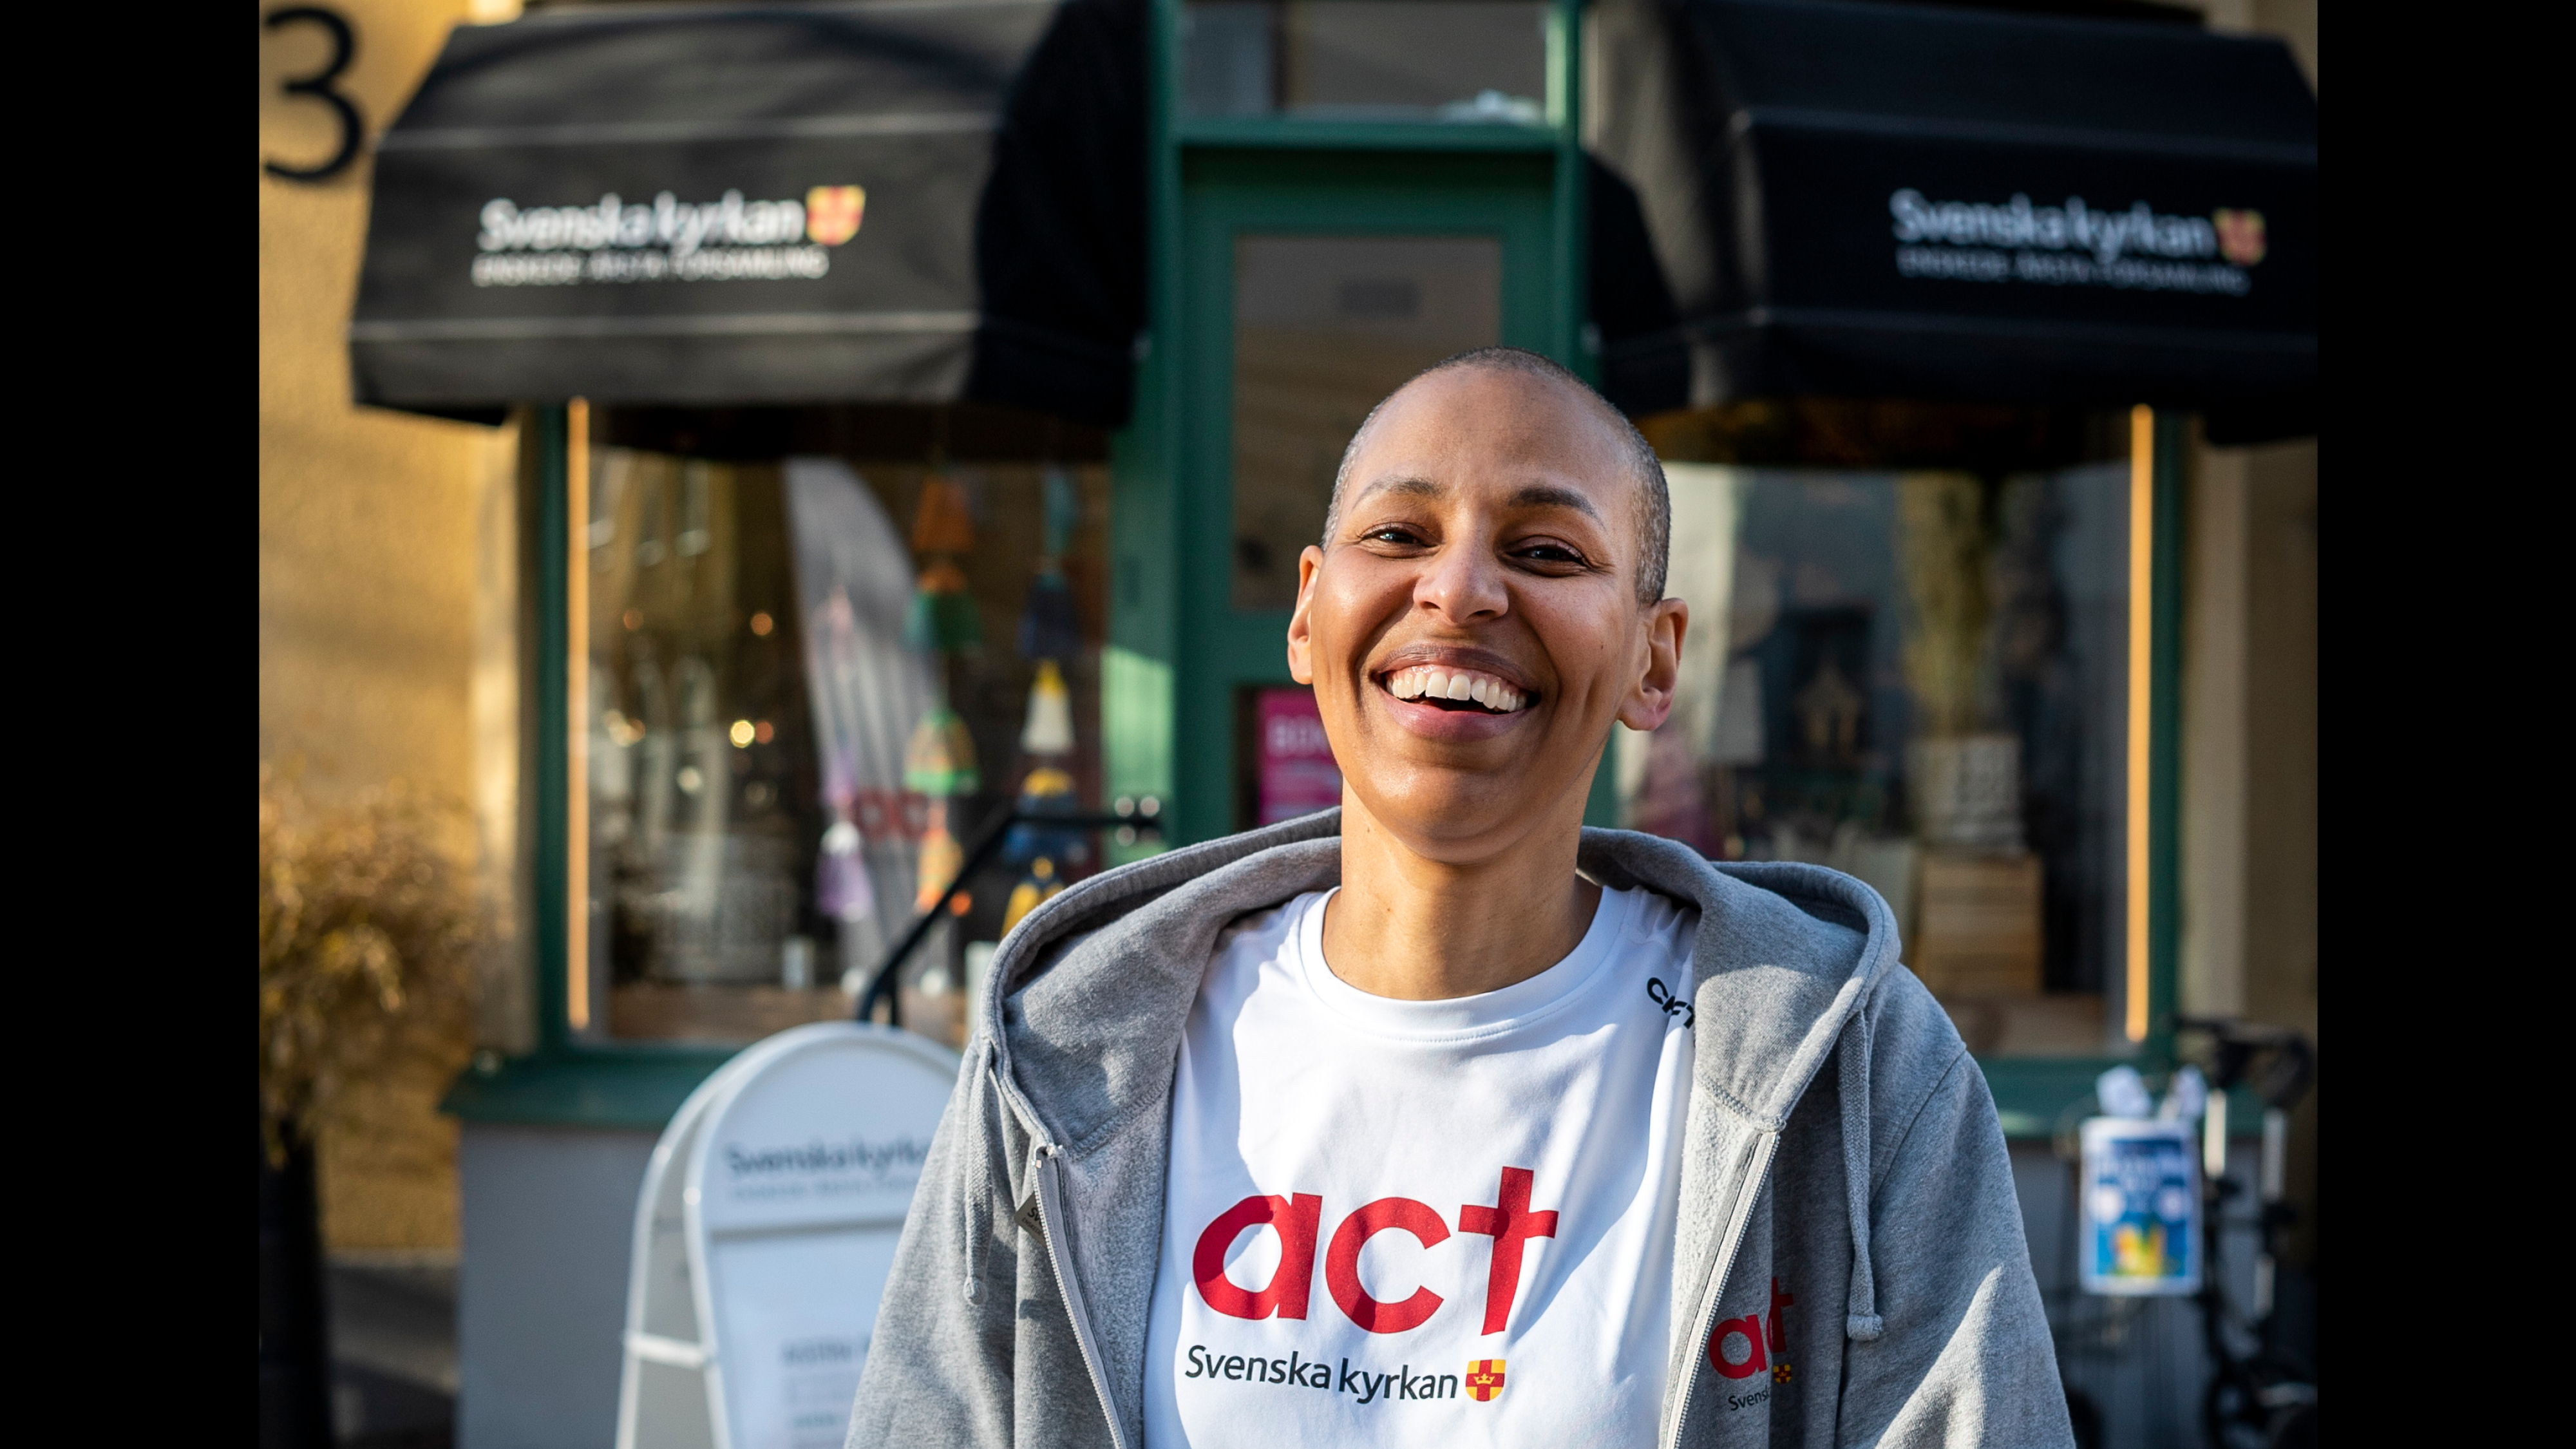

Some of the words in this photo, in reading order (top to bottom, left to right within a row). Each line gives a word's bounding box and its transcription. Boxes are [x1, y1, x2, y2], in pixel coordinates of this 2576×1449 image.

[261, 6, 362, 180] 3
[478, 192, 651, 251] Svenska
[653, 189, 805, 256] kyrkan
[1889, 188, 2066, 250] Svenska
[2066, 196, 2215, 264] kyrkan
[726, 1136, 849, 1177] Svenska
[1193, 1166, 1559, 1336] act
[1185, 1345, 1332, 1390] Svenska
[1338, 1357, 1459, 1405] kyrkan
